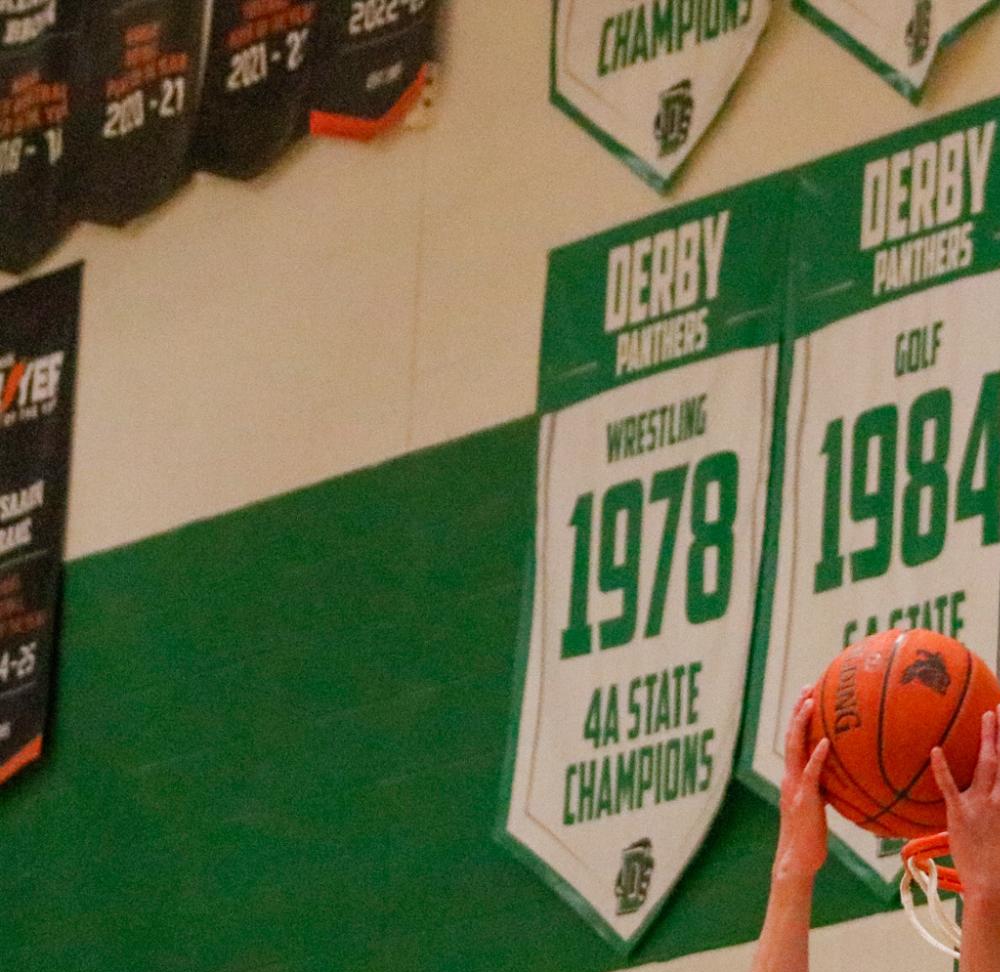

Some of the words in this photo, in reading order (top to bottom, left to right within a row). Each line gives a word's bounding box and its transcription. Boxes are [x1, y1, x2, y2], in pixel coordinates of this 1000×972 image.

[860, 121, 996, 250] DERBY
[604, 210, 730, 333] DERBY
[873, 222, 973, 295] PANTHERS
[615, 308, 708, 376] PANTHERS
[895, 321, 944, 377] GOLF
[607, 393, 706, 463] WRESTLING
[560, 451, 739, 660] 1978
[584, 683, 619, 749] 4A
[627, 661, 702, 740] STATE
[563, 728, 715, 825] CHAMPIONS
